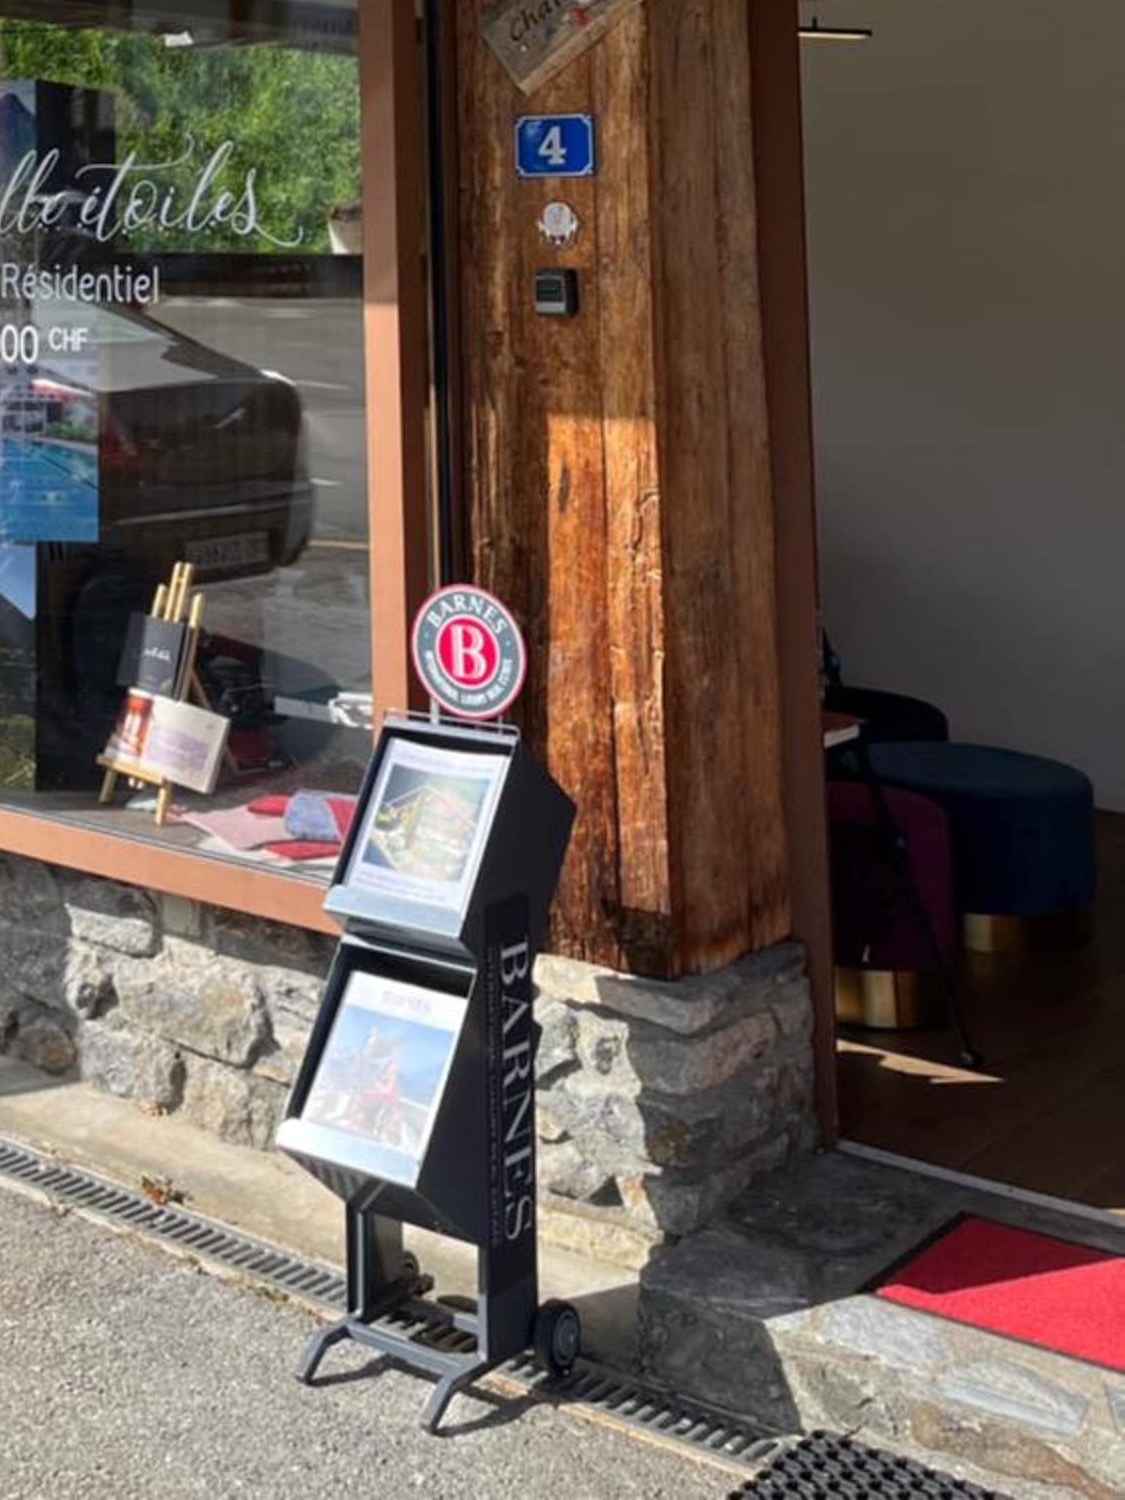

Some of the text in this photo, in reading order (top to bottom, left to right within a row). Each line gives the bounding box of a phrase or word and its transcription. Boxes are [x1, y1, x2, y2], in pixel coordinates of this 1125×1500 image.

[538, 125, 567, 165] 4
[0, 261, 159, 304] Résidentiel
[48, 326, 89, 351] CHF
[426, 593, 508, 635] BARNES
[450, 623, 488, 679] B
[500, 941, 533, 1241] BARNES
